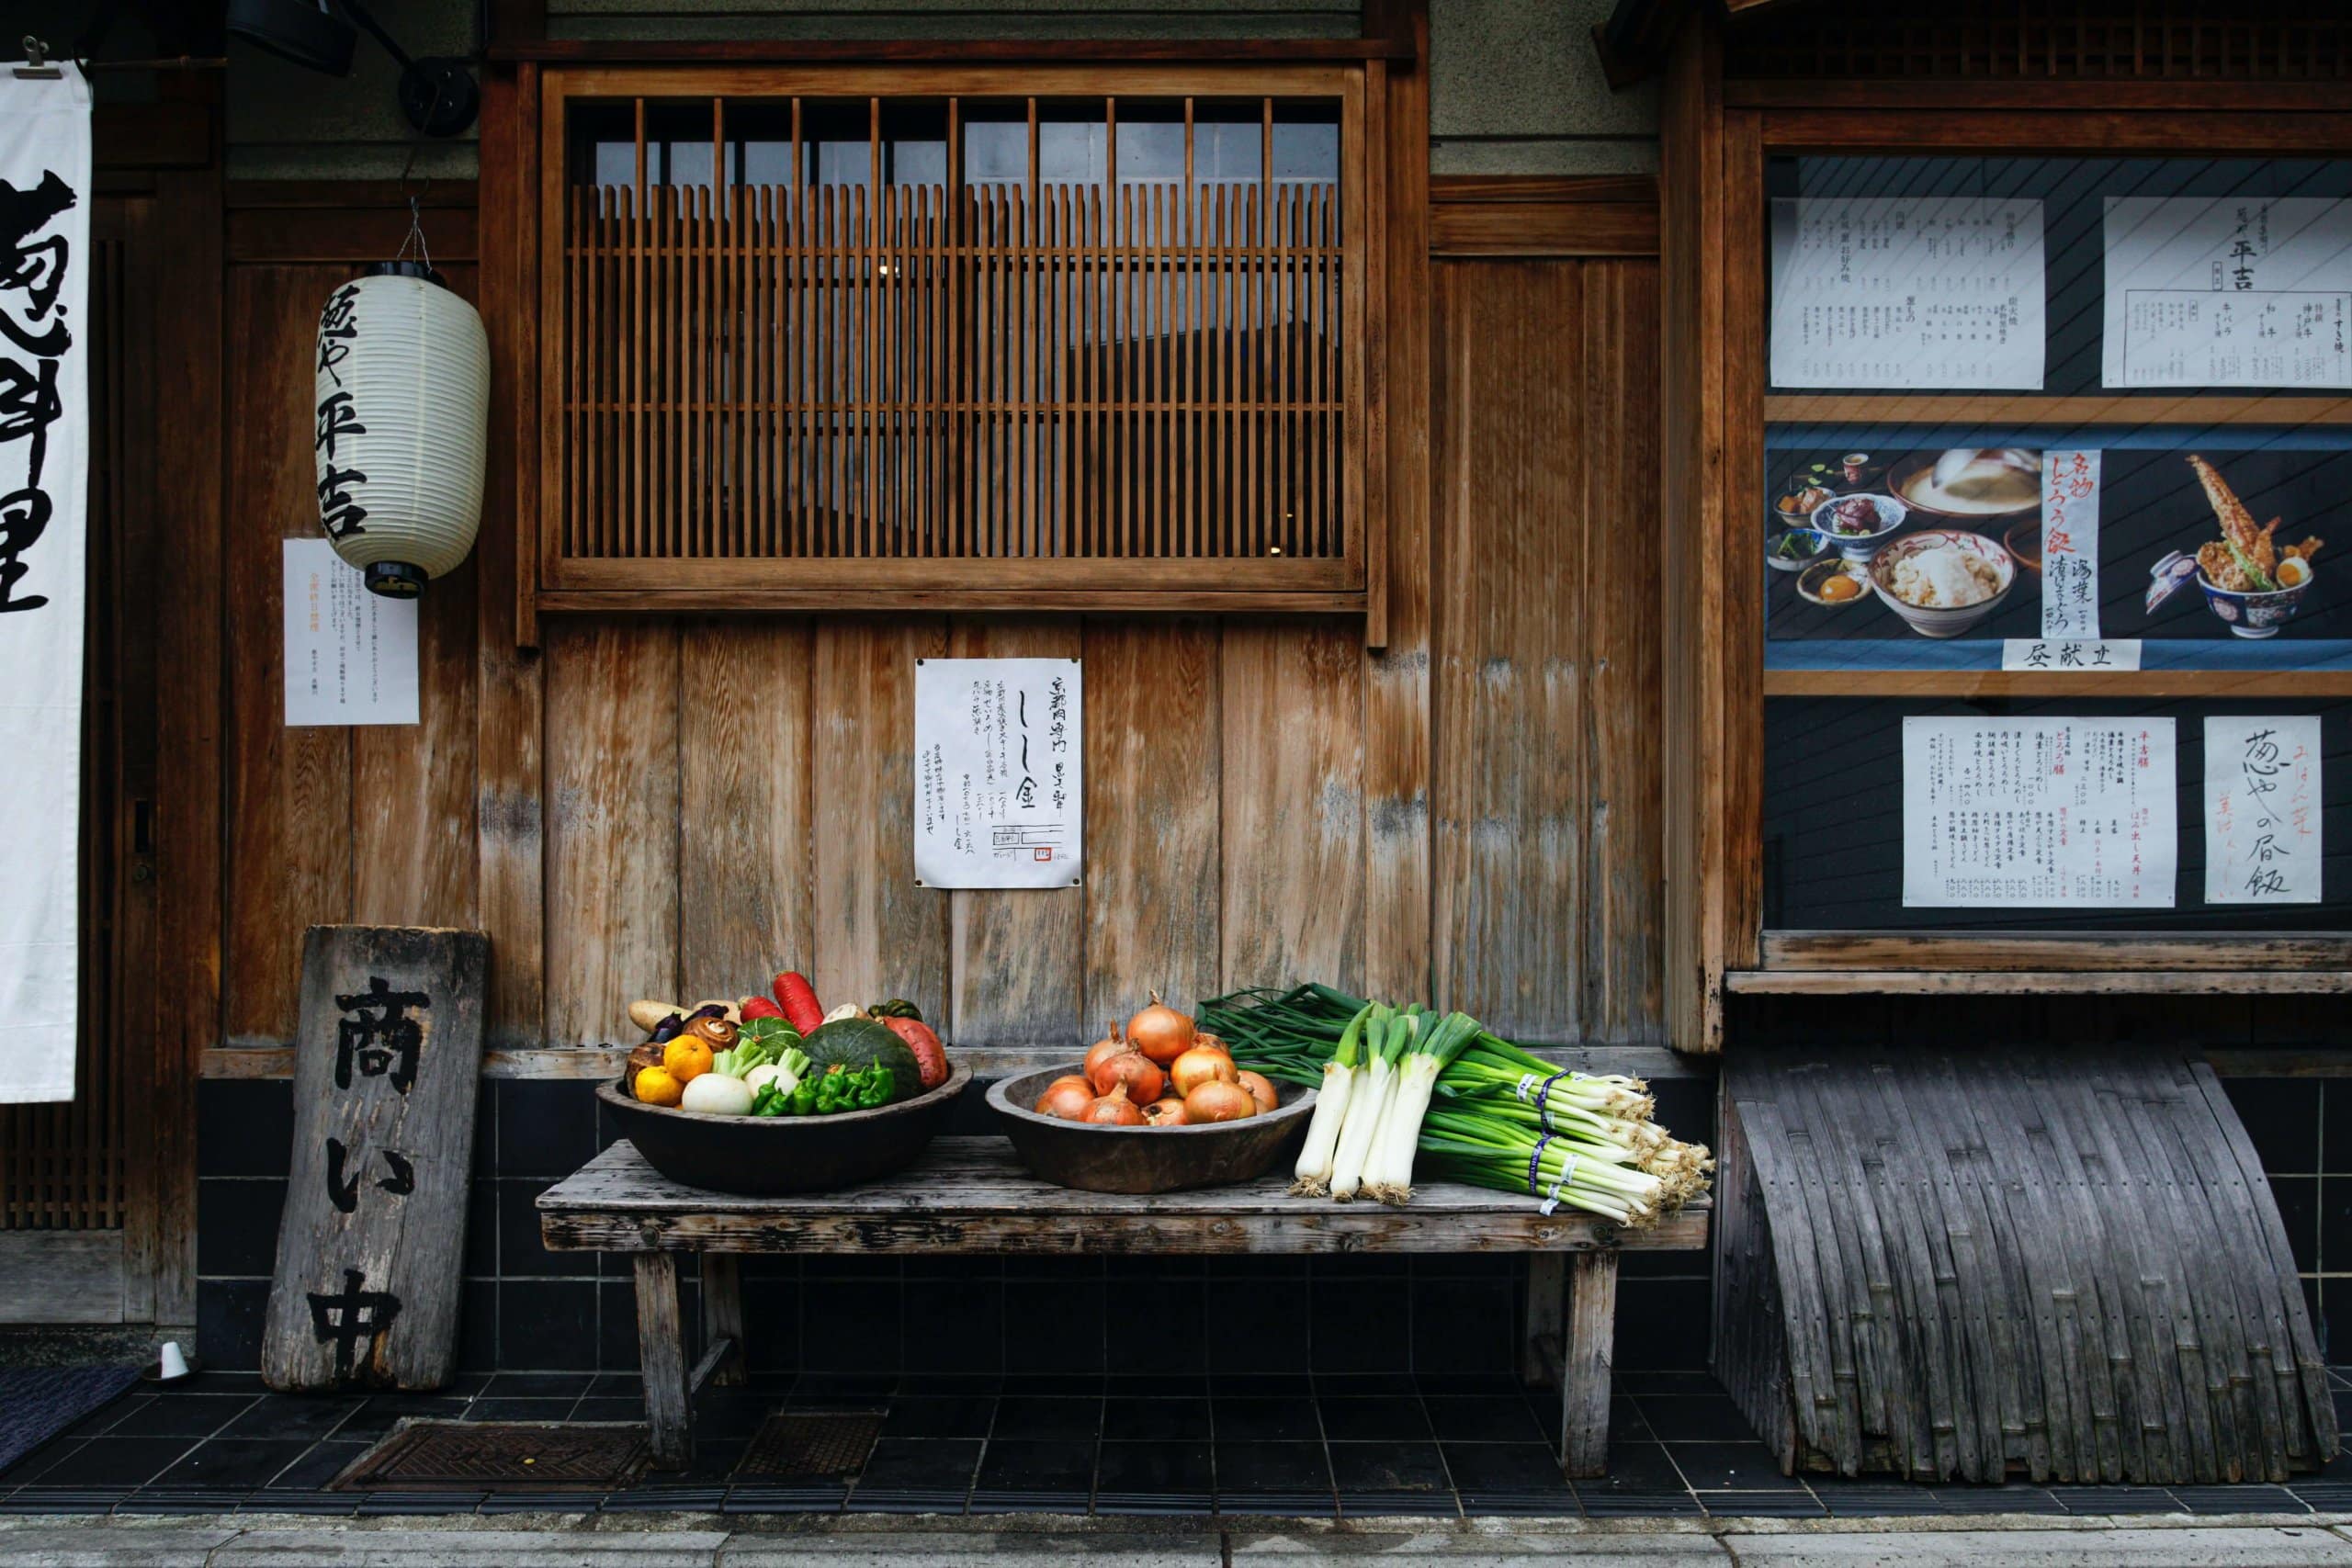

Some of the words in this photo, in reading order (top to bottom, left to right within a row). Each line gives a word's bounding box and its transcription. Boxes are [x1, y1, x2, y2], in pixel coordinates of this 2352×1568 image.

[2266, 302, 2277, 338] 和牛
[2302, 302, 2313, 338] 神戸牛
[315, 284, 368, 540] 葱や平吉
[2069, 454, 2095, 499] 名物
[2024, 644, 2111, 667] 昼献立
[2138, 730, 2150, 769] 平吉膳
[2243, 728, 2291, 897] 葱やの昼飯
[306, 976, 430, 1378] 商い中
